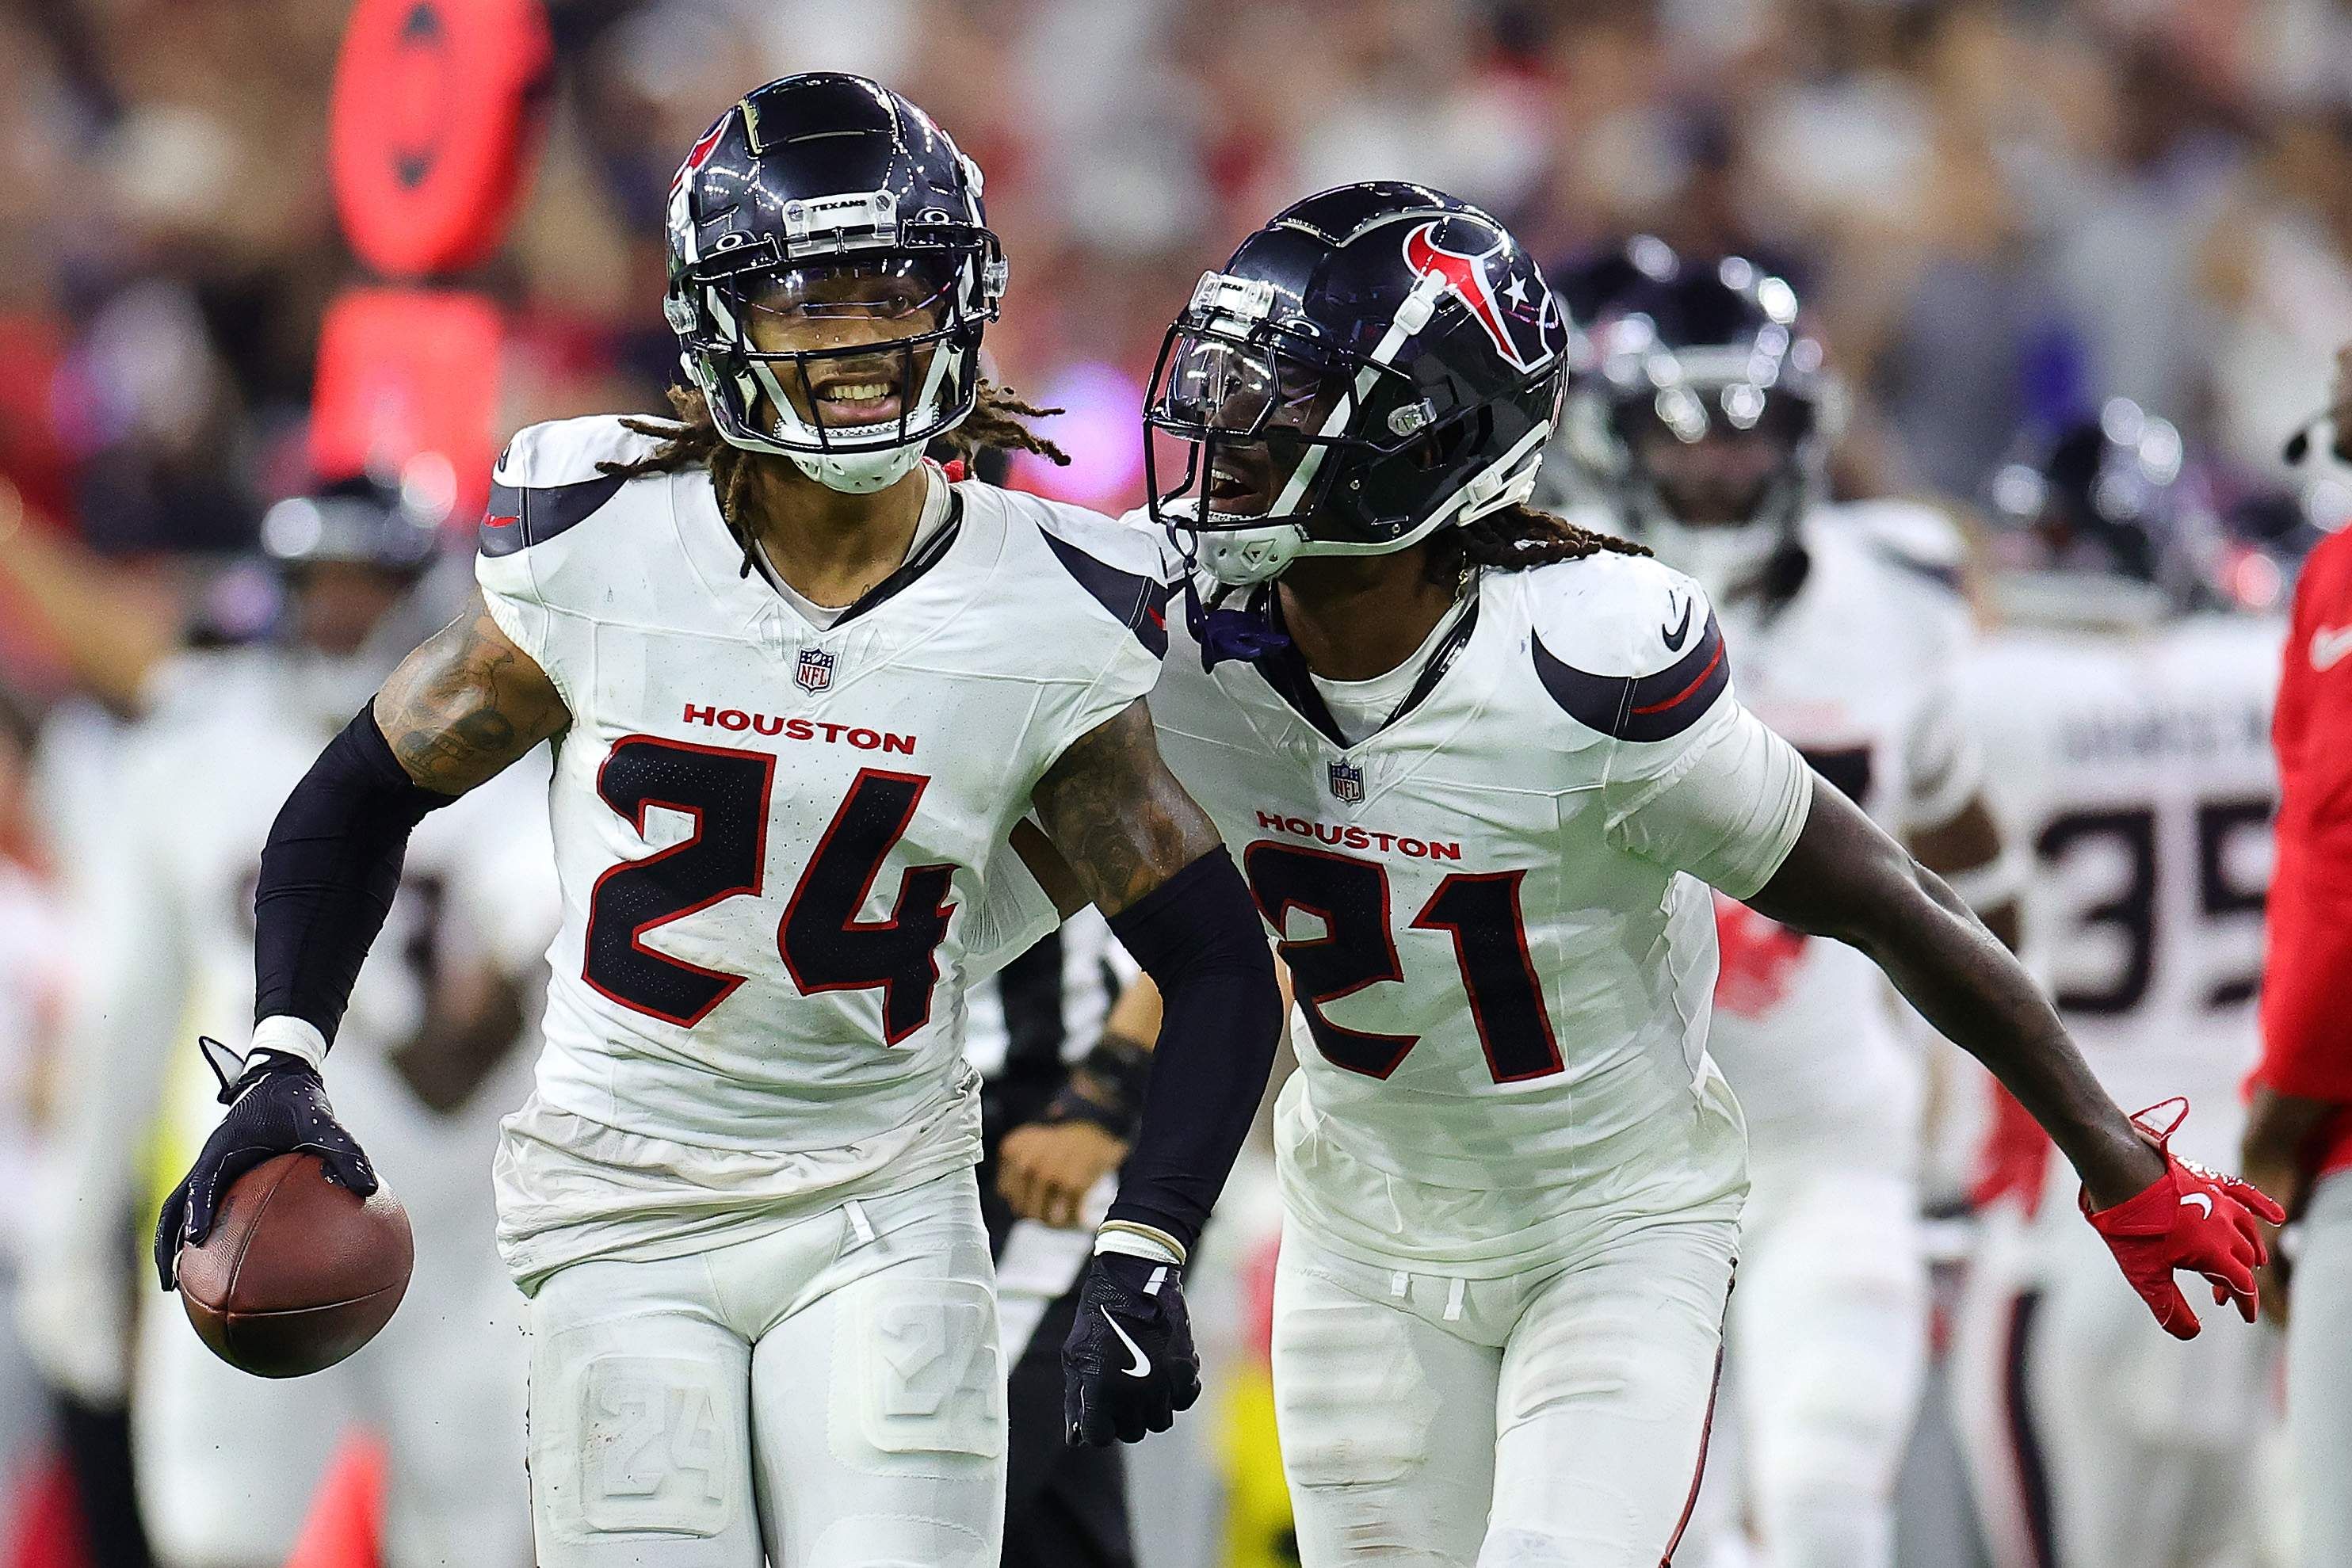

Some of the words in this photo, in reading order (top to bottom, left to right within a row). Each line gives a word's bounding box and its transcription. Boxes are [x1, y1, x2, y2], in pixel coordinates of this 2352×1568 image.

[810, 200, 867, 212] TEXANS
[800, 665, 827, 686] NFL
[683, 704, 917, 755] HOUSTON
[1335, 780, 1359, 799] NFL
[1255, 811, 1461, 860] HOUSTON
[581, 734, 961, 1047] 24
[2033, 795, 2273, 1018] 35
[1243, 840, 1564, 1084] 21
[601, 1383, 724, 1504] 24
